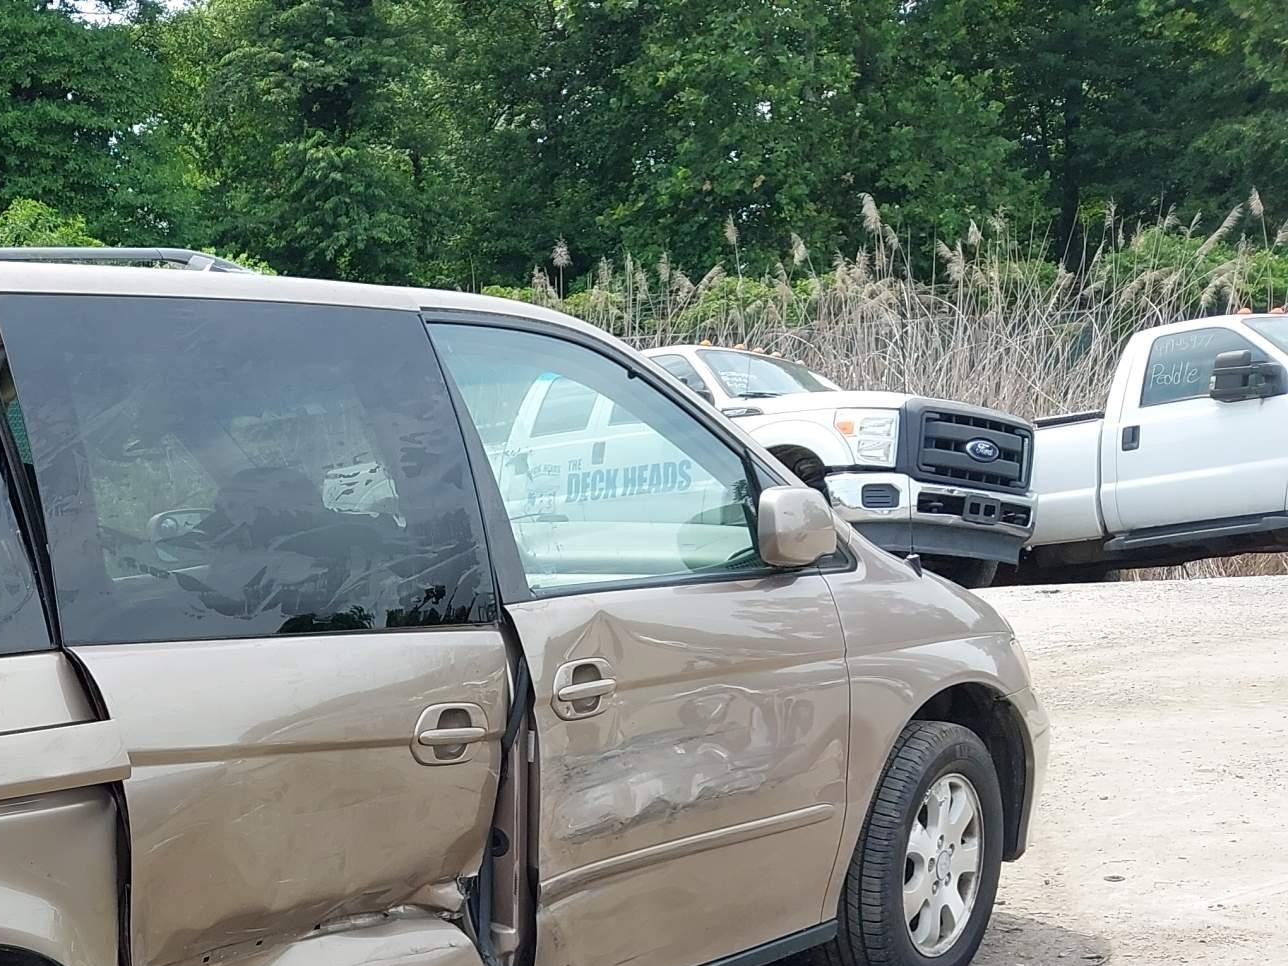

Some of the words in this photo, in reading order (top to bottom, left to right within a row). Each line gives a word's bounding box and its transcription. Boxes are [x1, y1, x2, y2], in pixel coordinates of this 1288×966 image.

[568, 458, 583, 472] THE
[565, 468, 619, 503] DECK
[621, 459, 692, 497] HEADS
